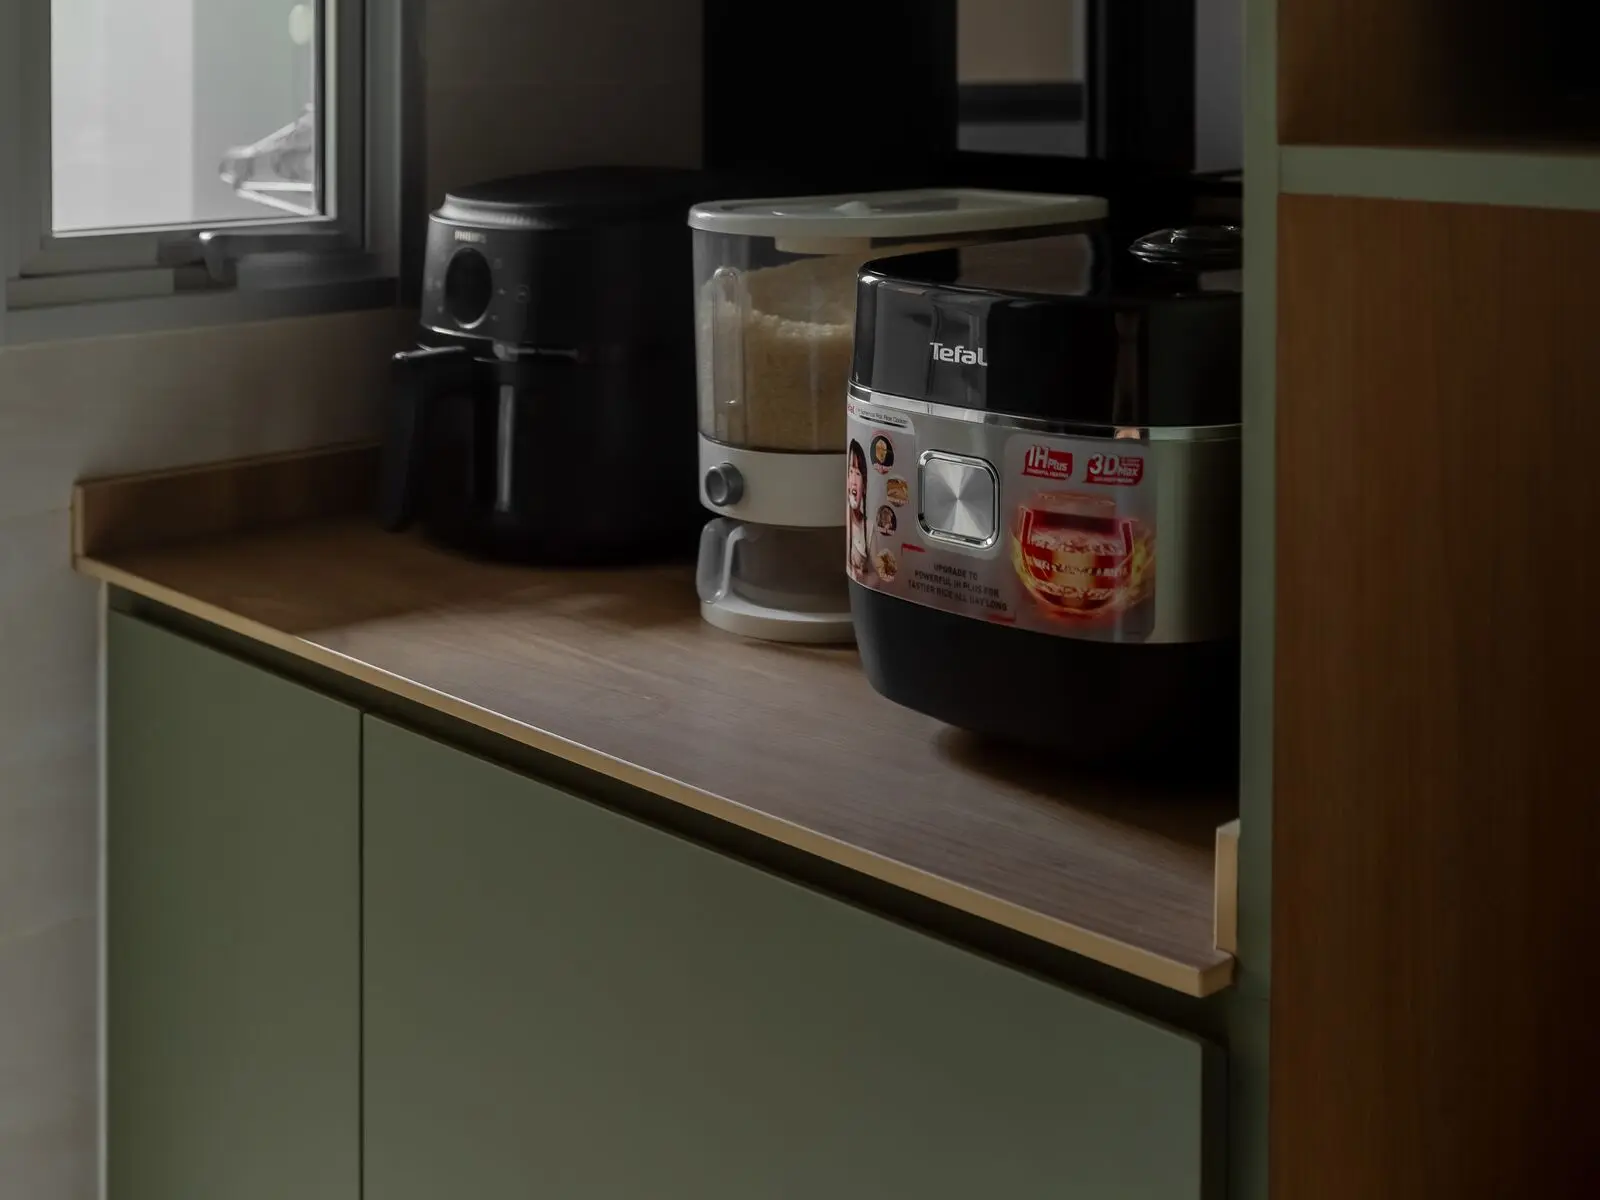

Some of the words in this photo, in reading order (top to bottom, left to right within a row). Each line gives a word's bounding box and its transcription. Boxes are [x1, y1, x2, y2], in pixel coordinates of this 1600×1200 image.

[929, 342, 988, 367] Tefal
[1028, 445, 1050, 469] IH
[1089, 453, 1120, 476] 3D
[914, 570, 952, 587] POWERFUL
[934, 563, 966, 578] UPGRADE
[969, 571, 978, 581] TO
[908, 579, 936, 594] TASTIER
[986, 599, 1008, 612] LONG
